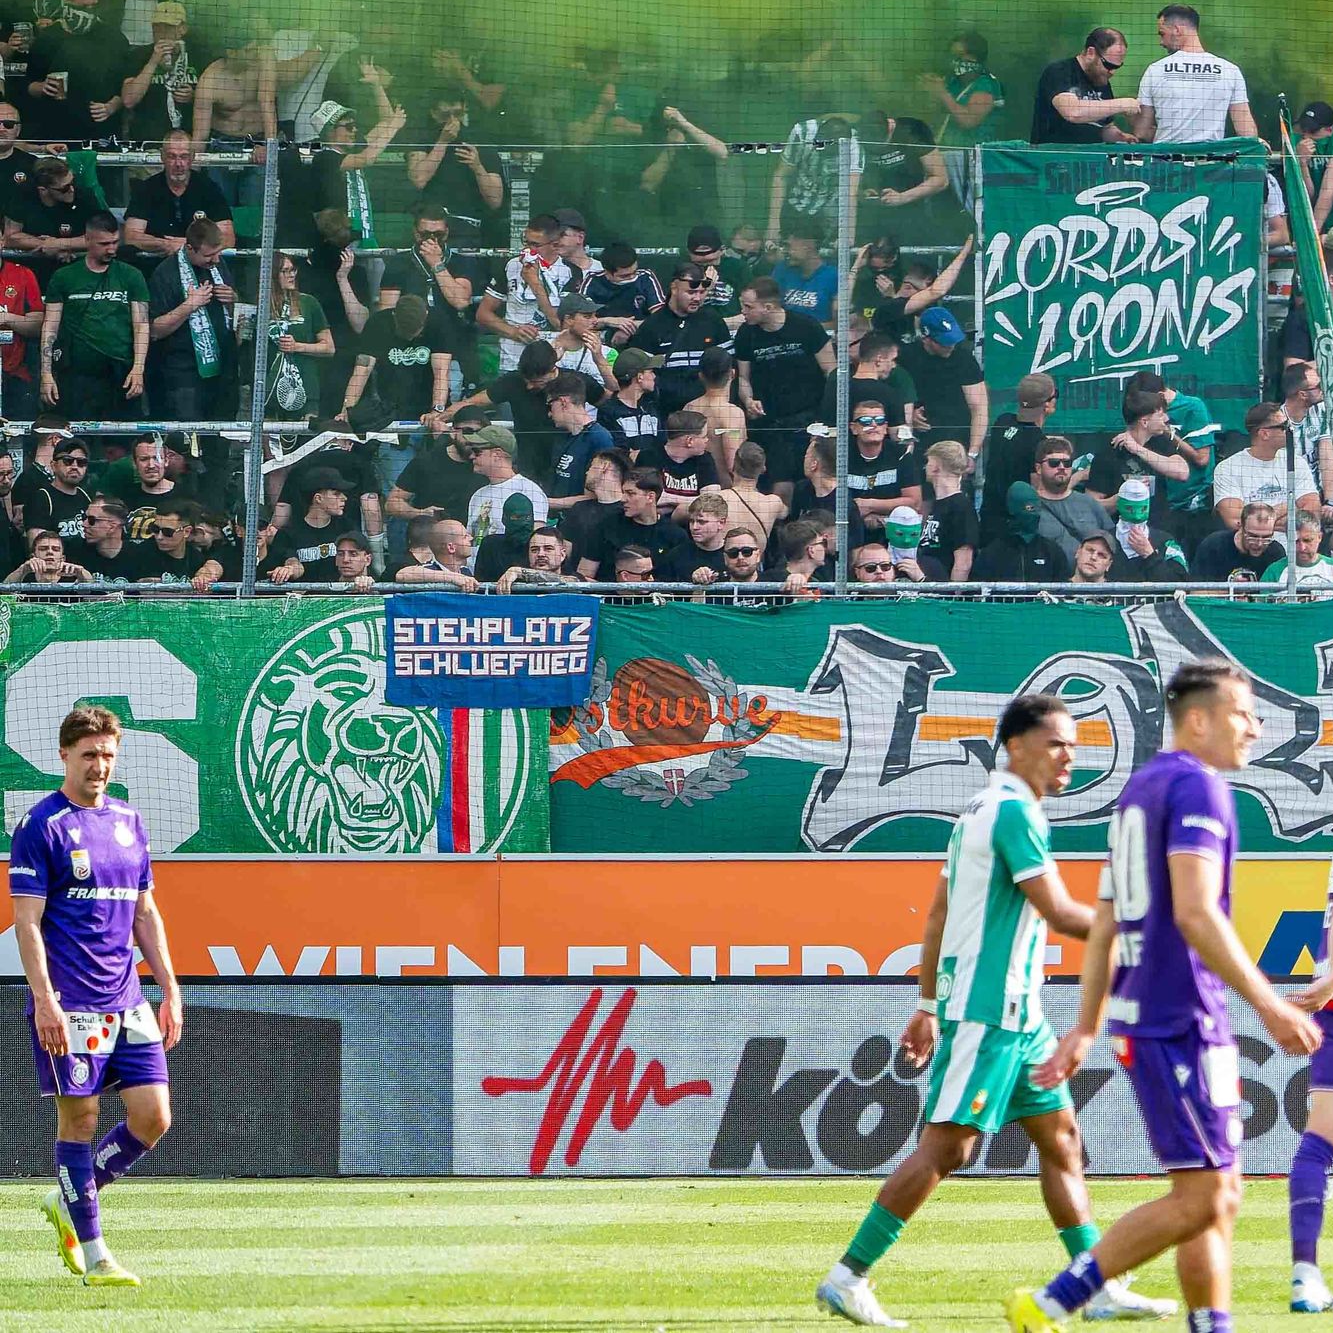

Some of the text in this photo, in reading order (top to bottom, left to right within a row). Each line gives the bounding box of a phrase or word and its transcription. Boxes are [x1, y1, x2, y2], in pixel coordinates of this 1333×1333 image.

[1163, 62, 1222, 75] ULTRAS
[984, 195, 1211, 307] LORDS
[1031, 267, 1256, 374] LOONS
[393, 617, 593, 645] STEHPLATZ
[394, 651, 589, 678] SCHLUEFWEG
